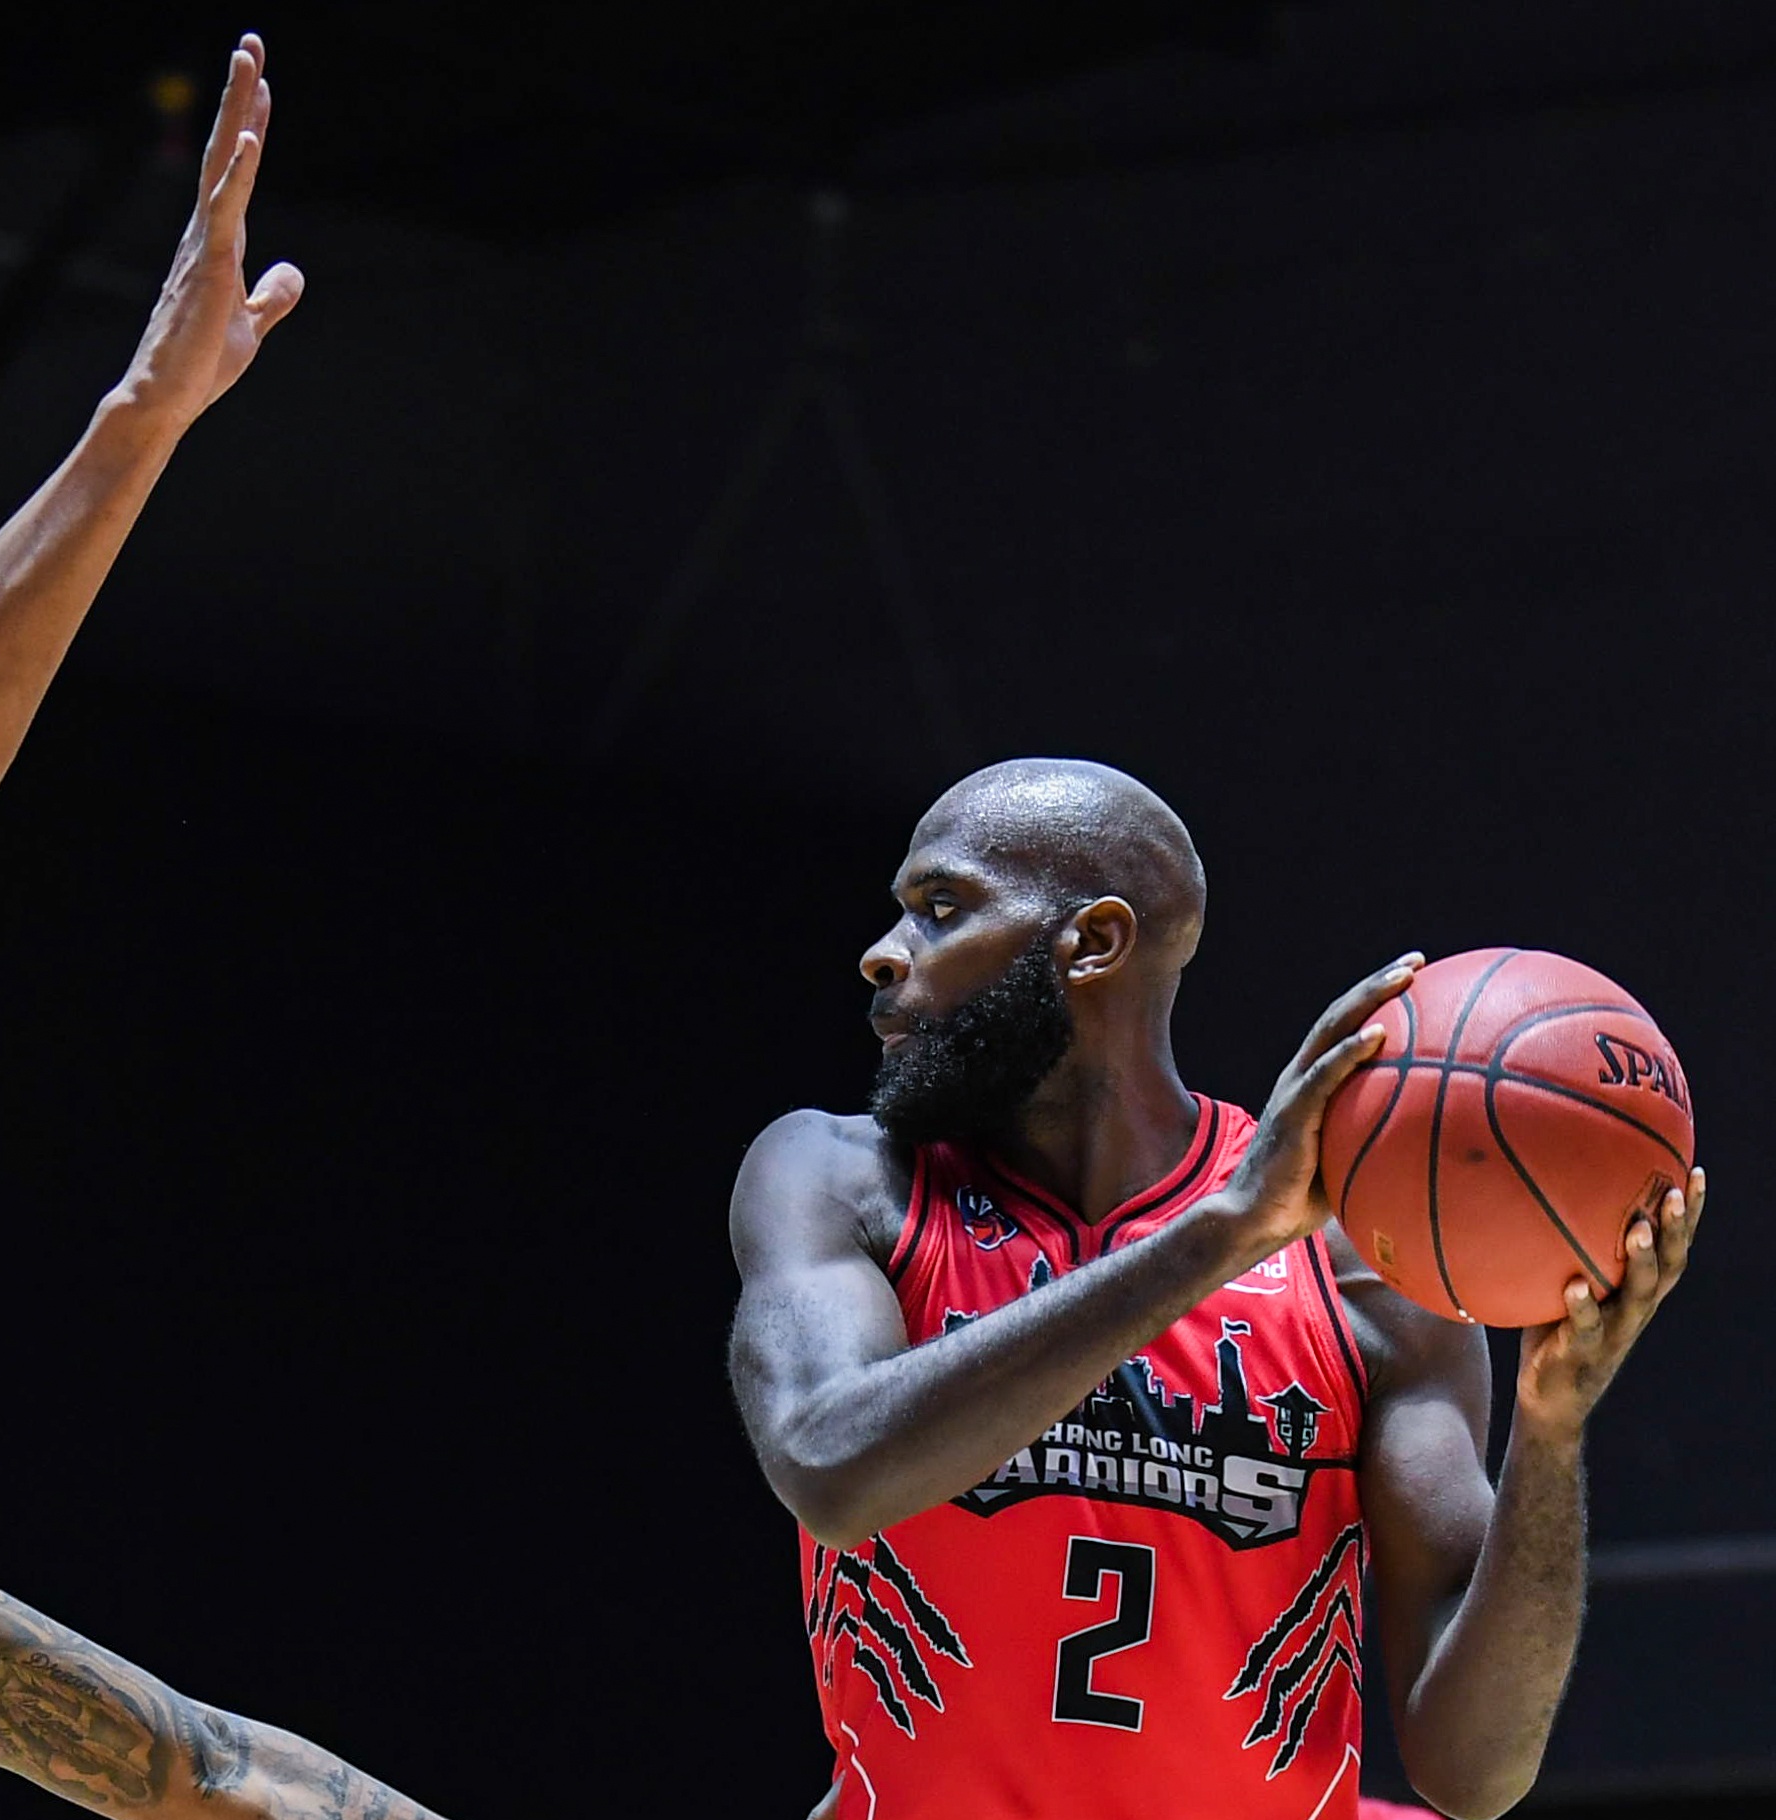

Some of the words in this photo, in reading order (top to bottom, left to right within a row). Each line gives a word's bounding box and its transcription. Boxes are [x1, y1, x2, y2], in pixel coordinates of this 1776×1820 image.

[1041, 1422, 1122, 1451] HANG
[1132, 1432, 1215, 1468] LONG
[993, 1446, 1307, 1540] ARRIORS
[1052, 1536, 1156, 1733] 2
